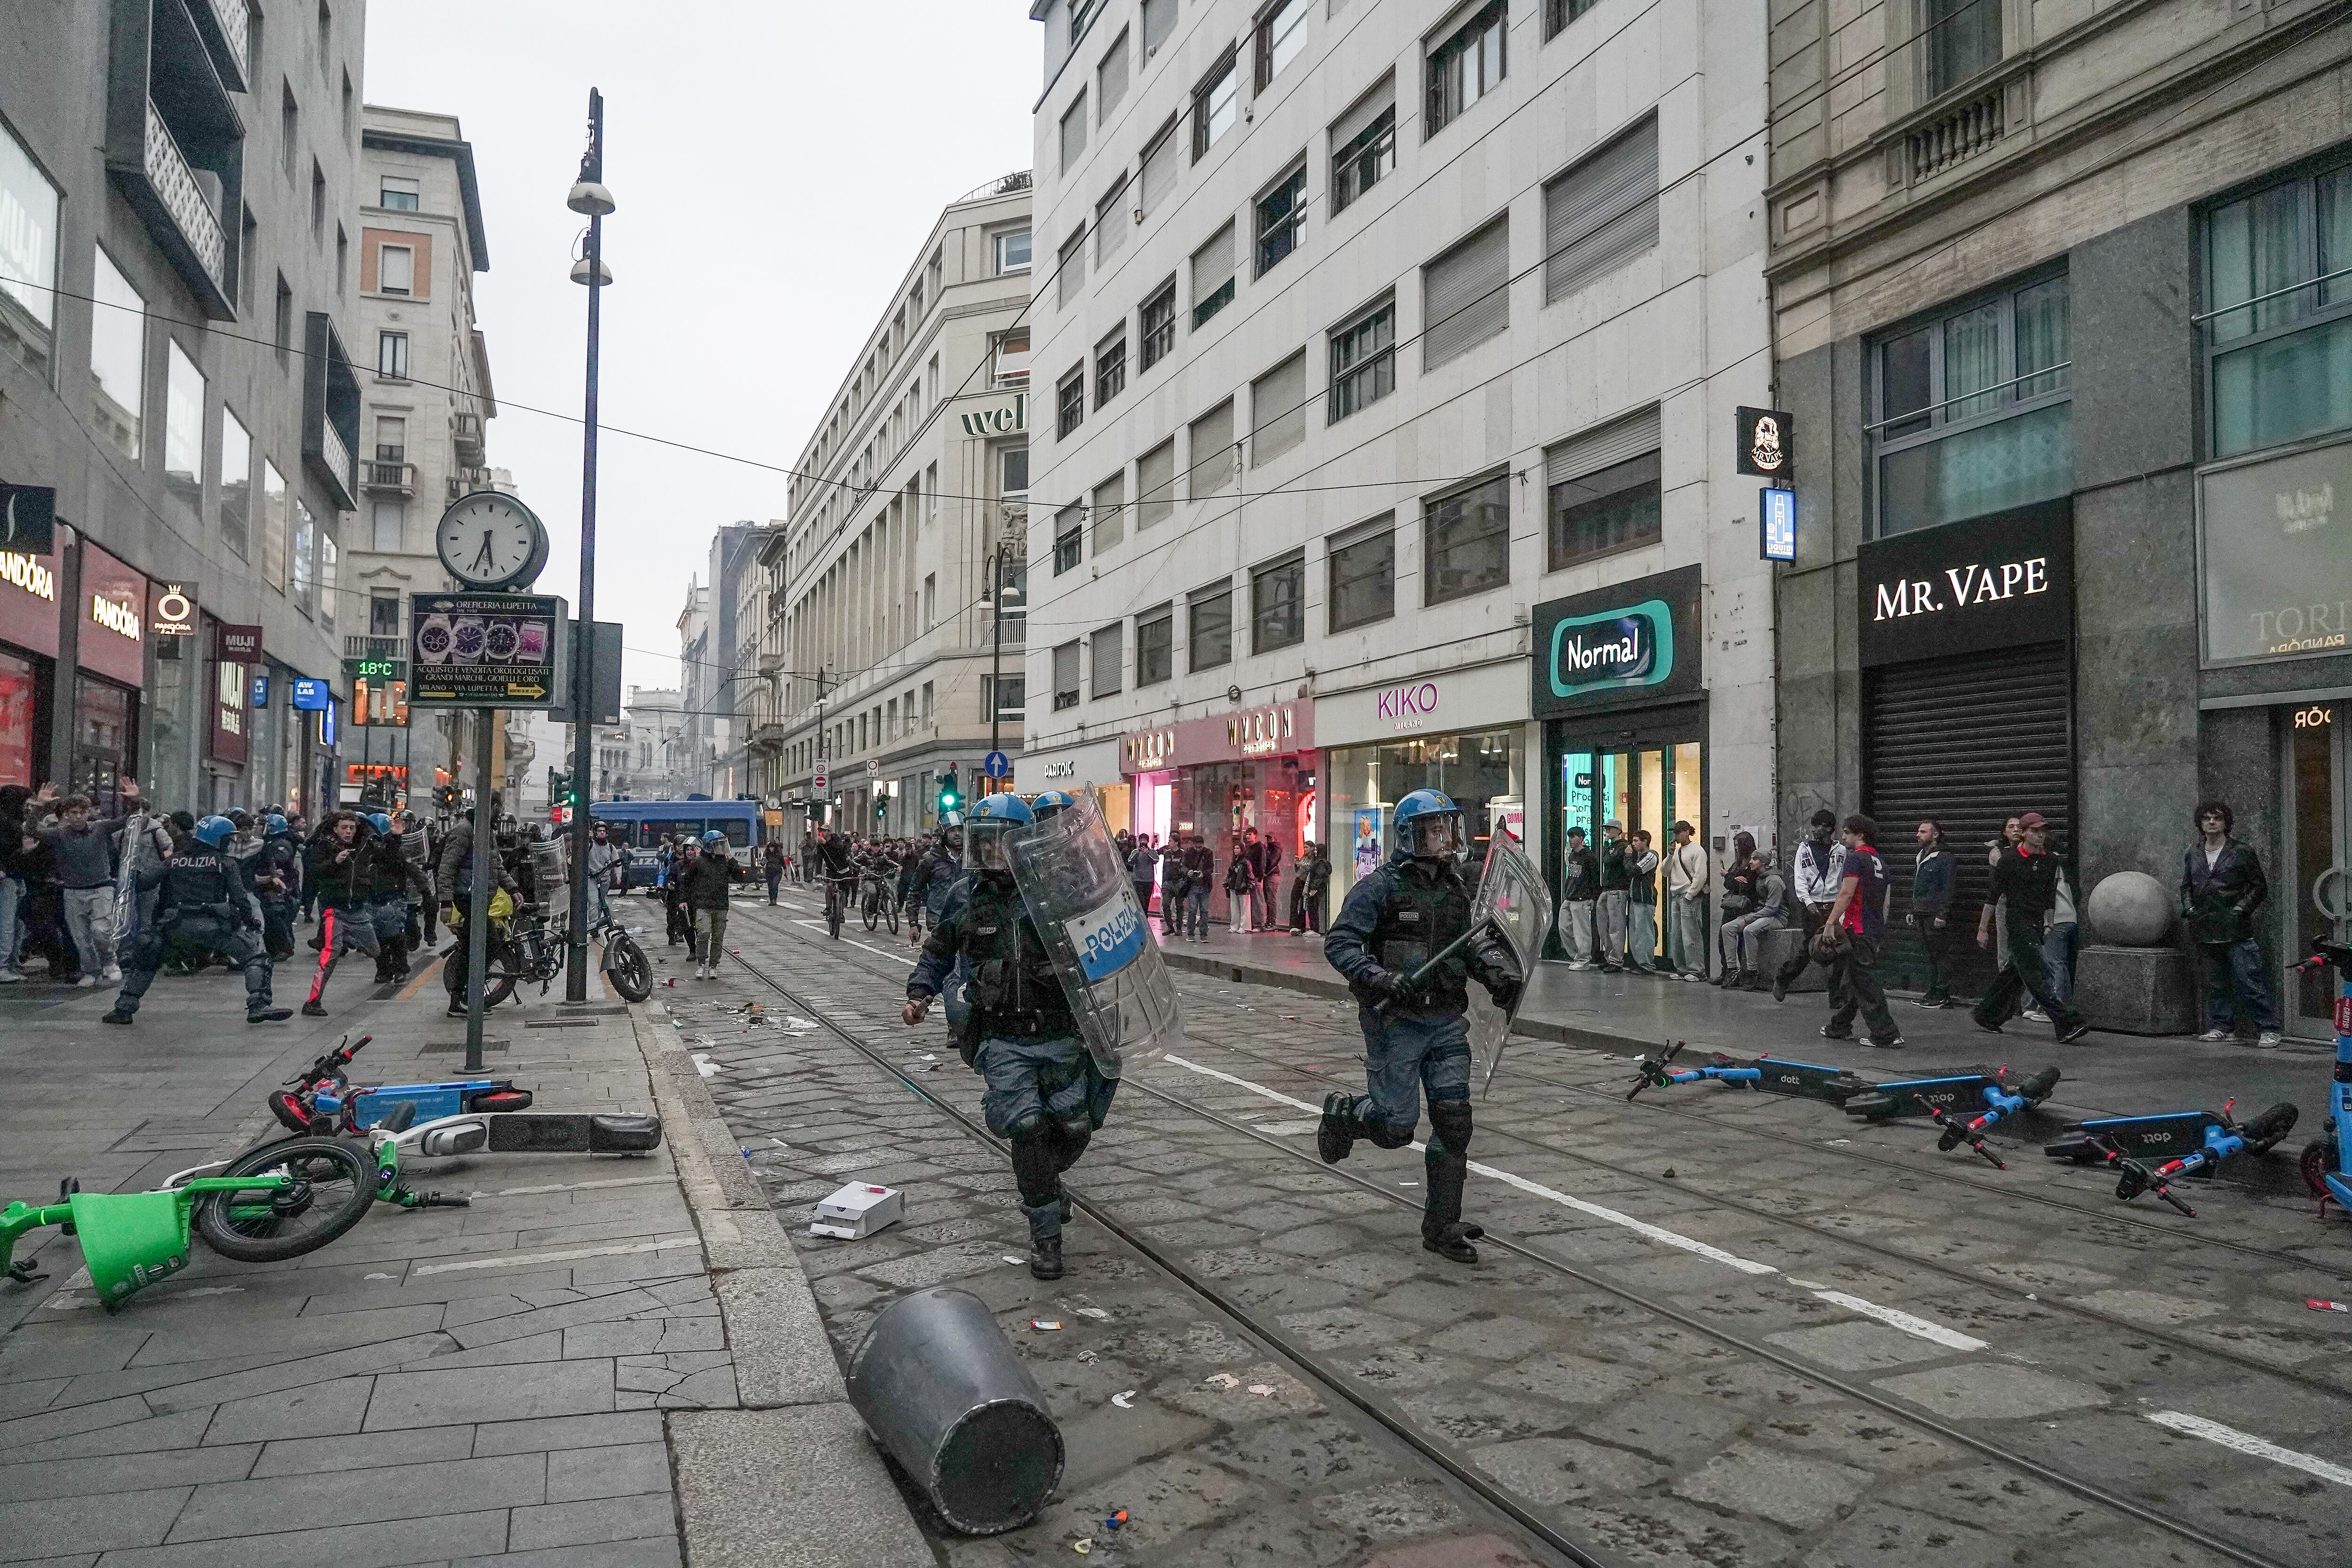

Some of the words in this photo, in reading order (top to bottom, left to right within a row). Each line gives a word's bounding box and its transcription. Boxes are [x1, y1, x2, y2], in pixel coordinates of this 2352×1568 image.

[961, 393, 1029, 437] wel
[1767, 543, 1793, 552] LIQUIDI
[1945, 557, 2048, 606] VAPE
[1568, 628, 1638, 671] Normal
[359, 661, 392, 675] 18°C
[1378, 683, 1439, 719] KIKO
[1227, 708, 1292, 746] WYCON
[1394, 719, 1422, 730] MILANO
[1127, 732, 1174, 761] WYCON
[1243, 741, 1275, 753] cosmetics
[1045, 761, 1074, 778] PARFOIS
[171, 856, 217, 868] POLIZIA
[1871, 855, 1883, 879] 2
[1085, 903, 1141, 961] POLIZIA
[1780, 1075, 1802, 1084] dott
[2141, 1132, 2171, 1144] dott
